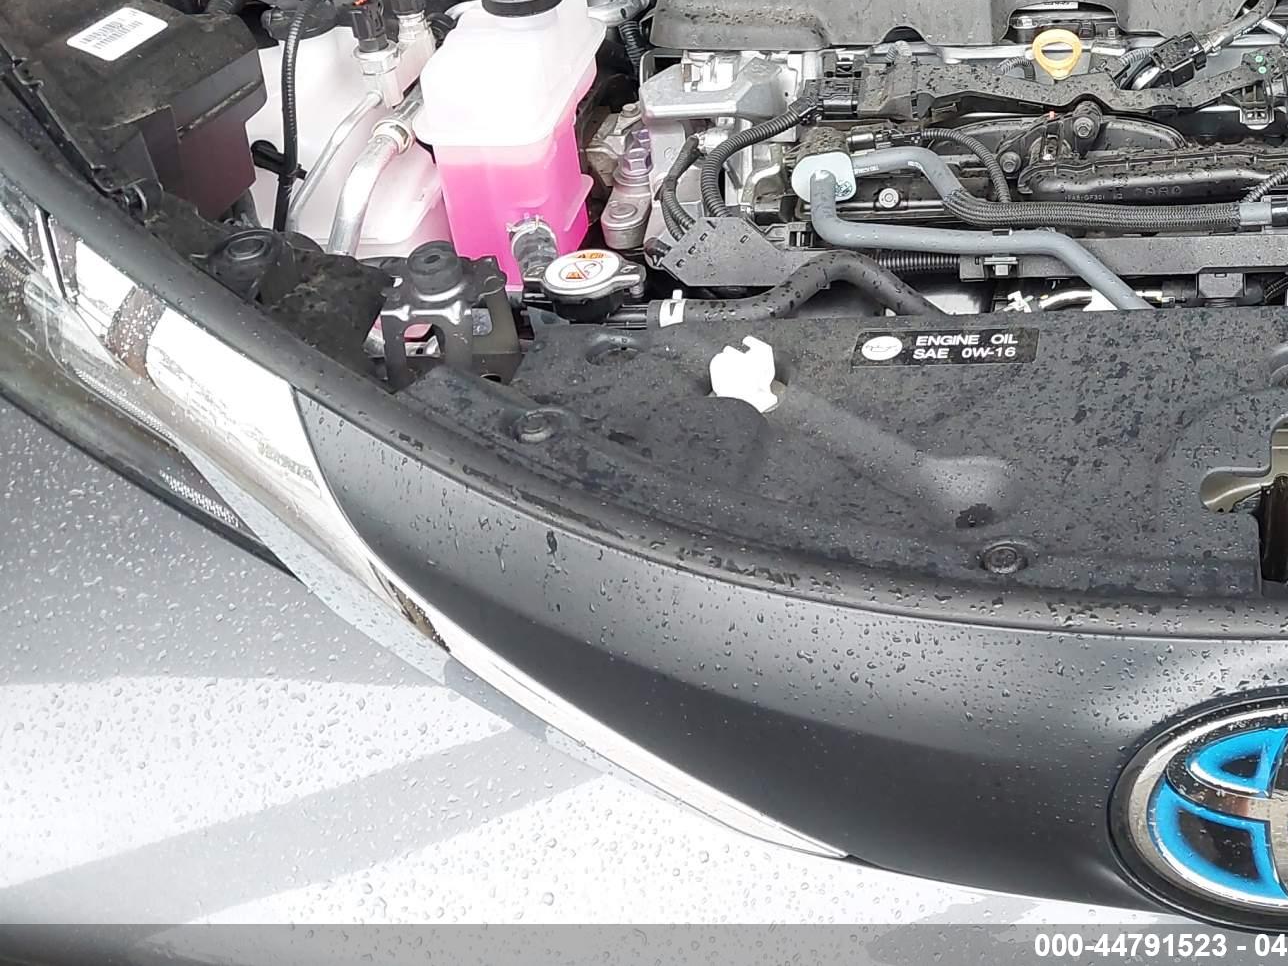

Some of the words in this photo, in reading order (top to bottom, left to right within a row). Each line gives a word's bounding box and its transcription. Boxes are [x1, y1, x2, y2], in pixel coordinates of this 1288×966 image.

[915, 334, 979, 346] ENGINE
[990, 334, 1018, 344] OIL
[912, 347, 949, 360] SAE
[961, 347, 1016, 359] 0W-16
